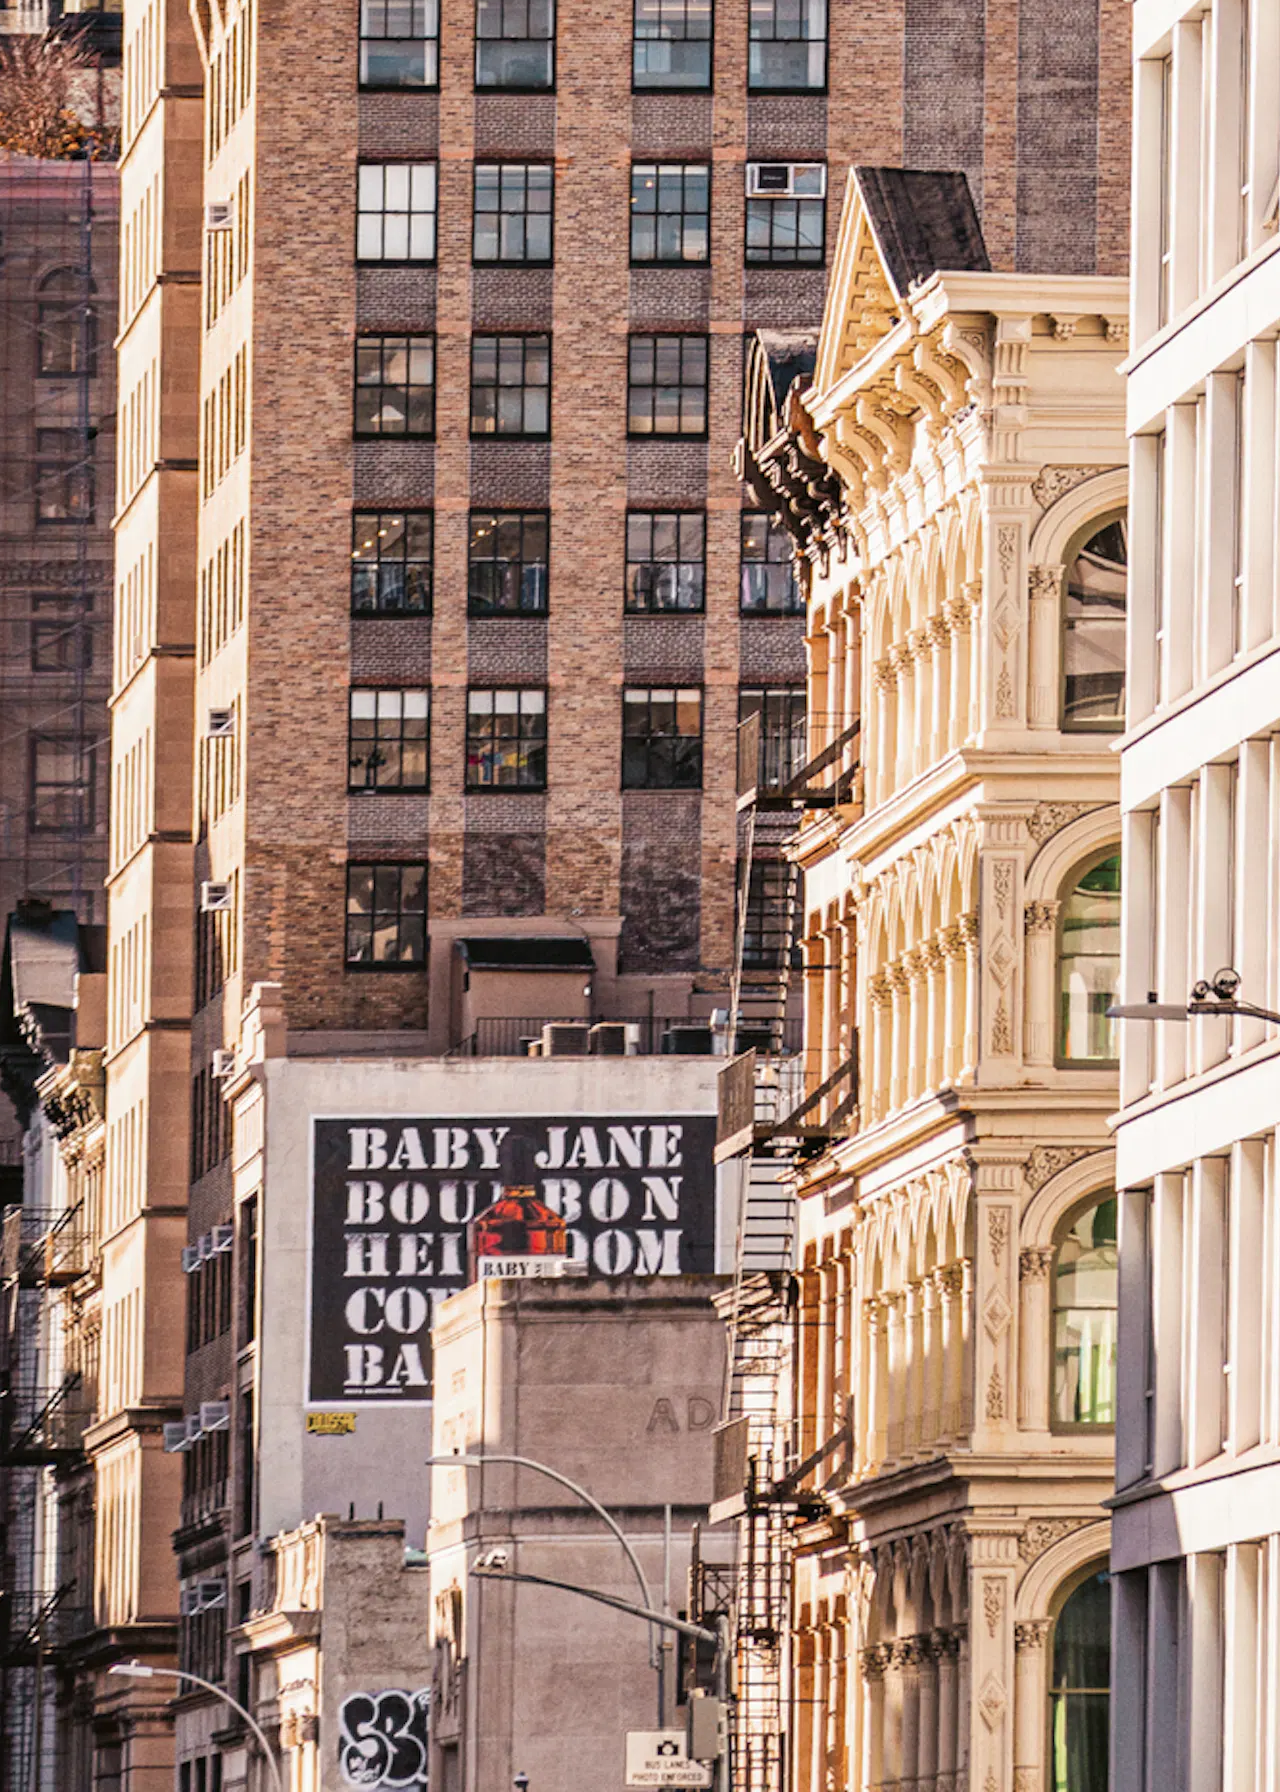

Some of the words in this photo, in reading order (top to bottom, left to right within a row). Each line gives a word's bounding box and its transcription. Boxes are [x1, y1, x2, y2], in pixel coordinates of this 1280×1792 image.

[346, 1126, 510, 1170] BABY
[533, 1124, 683, 1169] JANE
[344, 1176, 683, 1225] BOUBON
[483, 1262, 529, 1276] BABY
